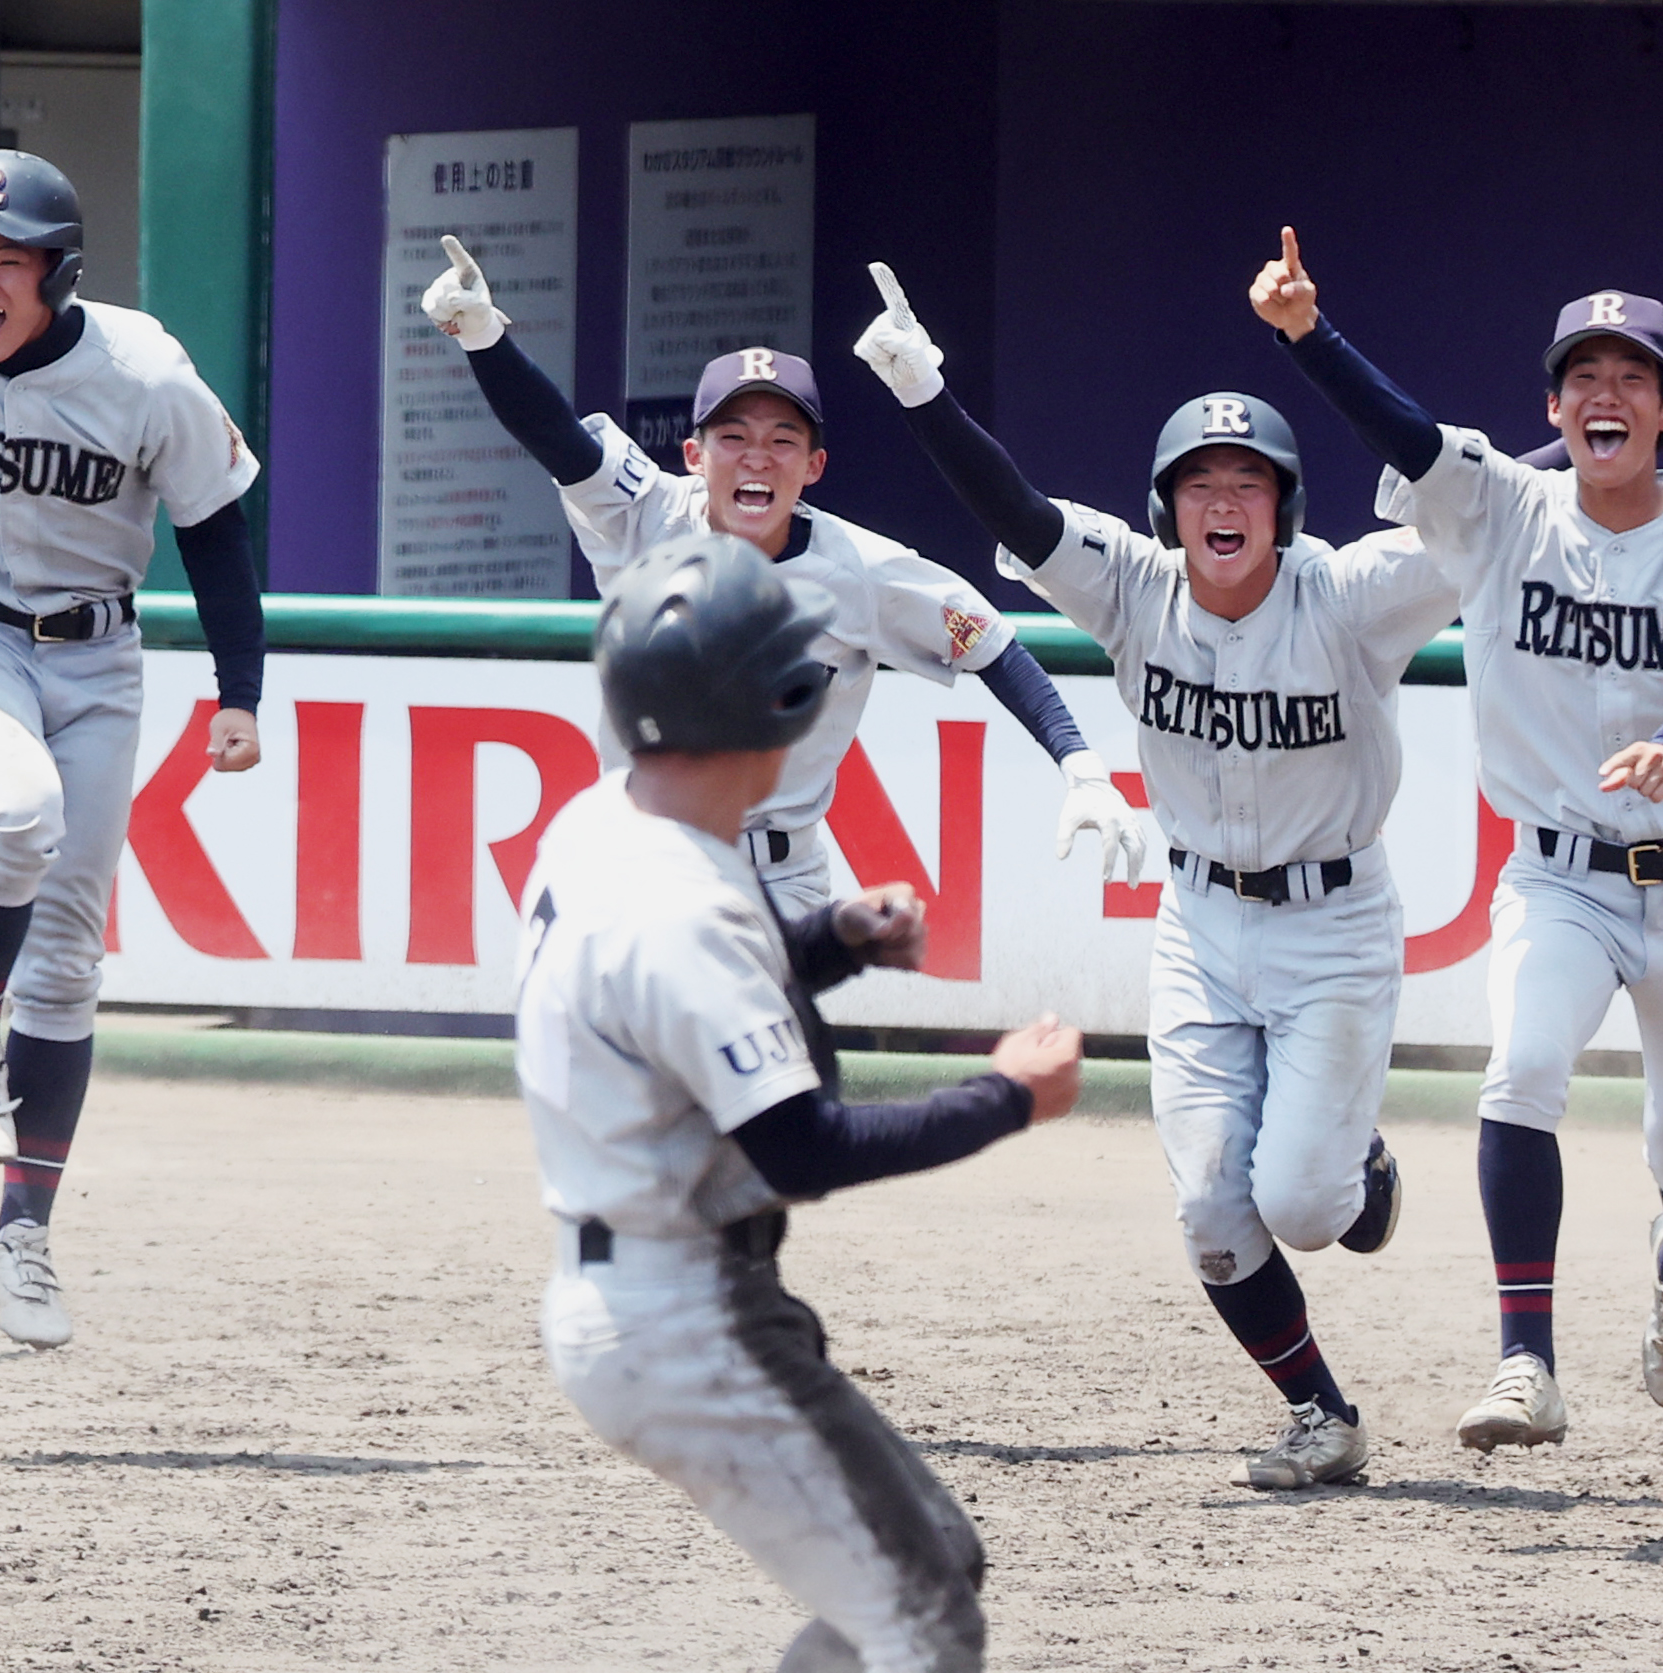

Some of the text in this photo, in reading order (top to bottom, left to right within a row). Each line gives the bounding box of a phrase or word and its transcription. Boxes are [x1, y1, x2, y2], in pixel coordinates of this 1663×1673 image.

[1586, 293, 1627, 326] R
[737, 348, 778, 381] R
[1204, 399, 1252, 436] R
[1140, 661, 1346, 751] RITSUMEI
[104, 698, 986, 982] KIRN
